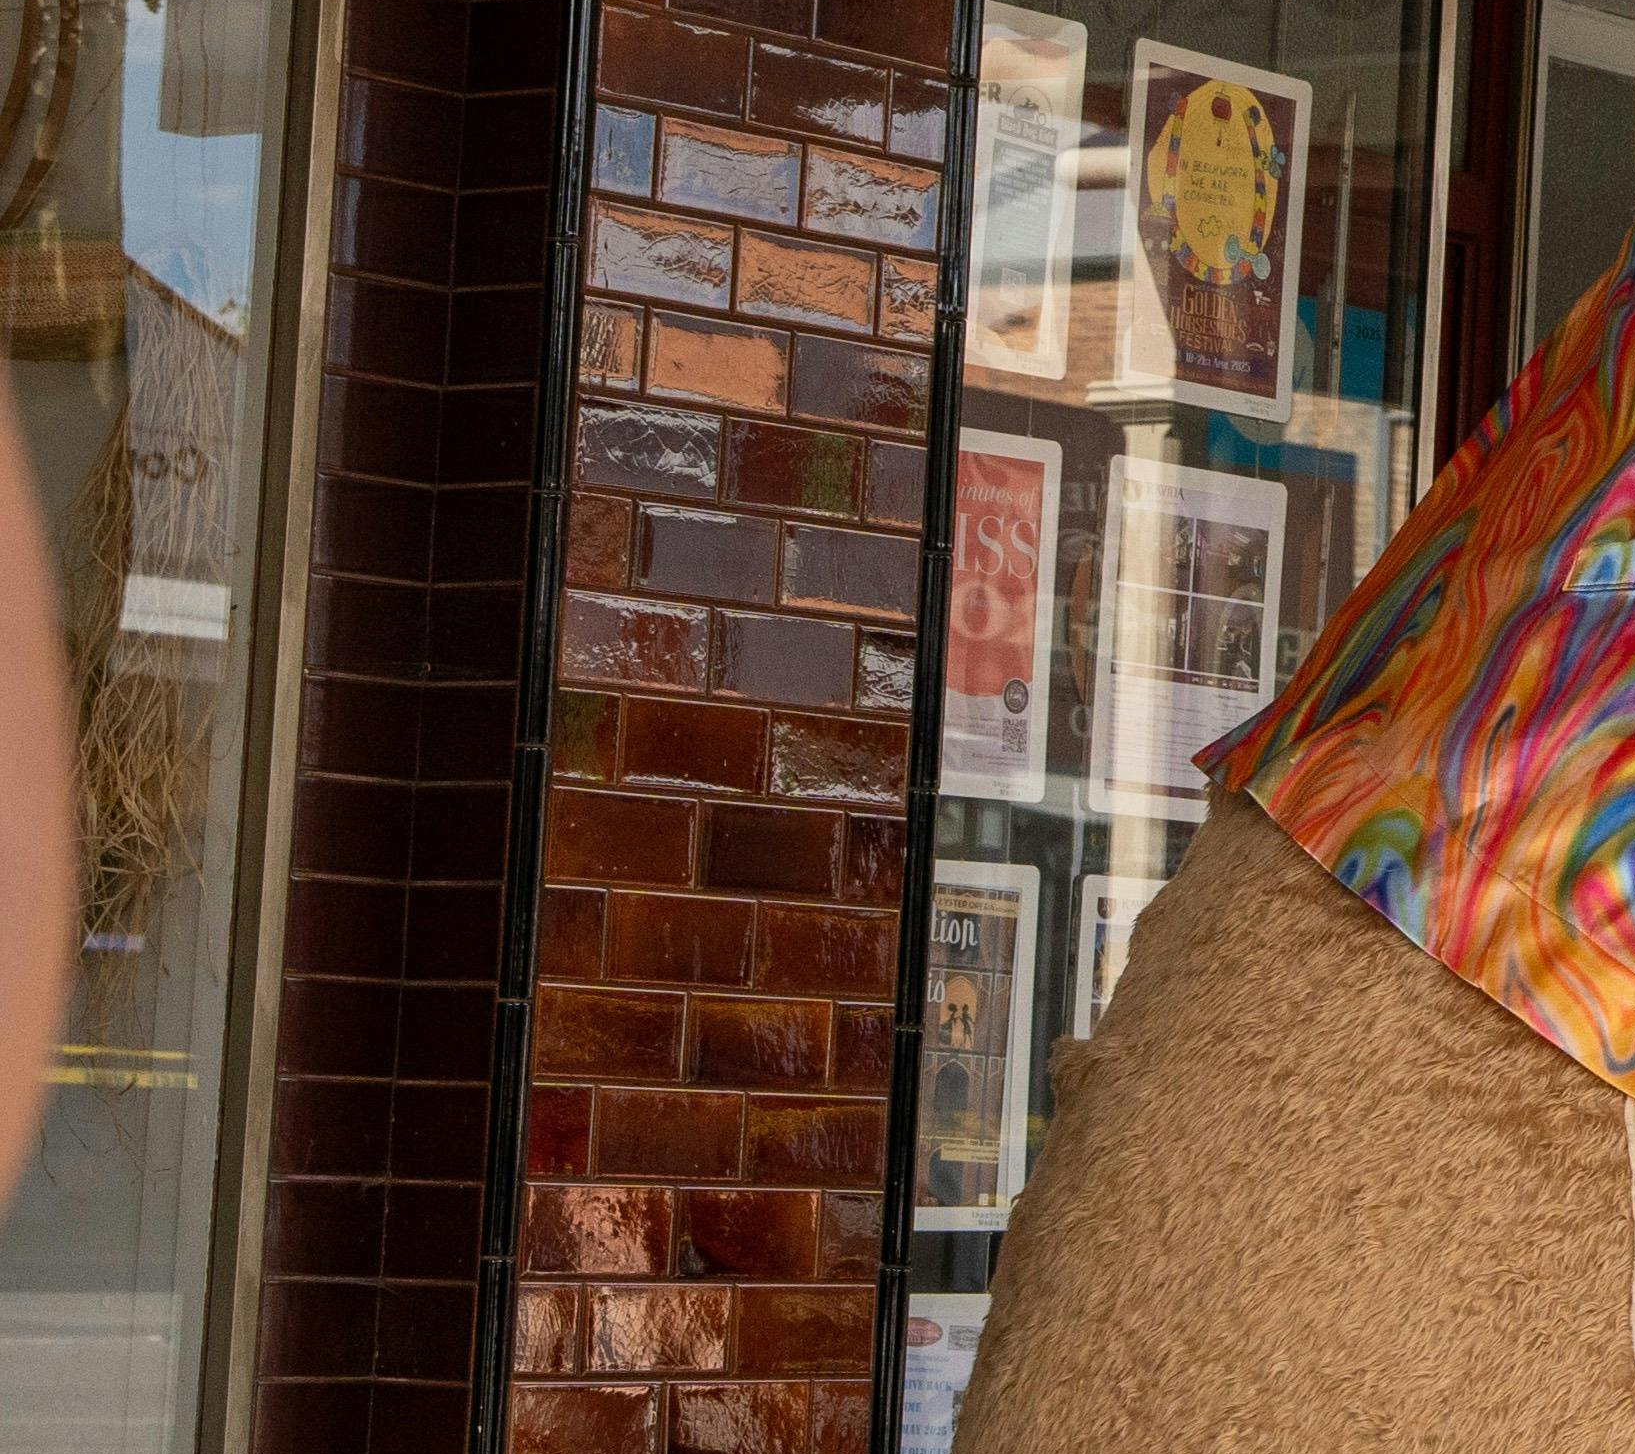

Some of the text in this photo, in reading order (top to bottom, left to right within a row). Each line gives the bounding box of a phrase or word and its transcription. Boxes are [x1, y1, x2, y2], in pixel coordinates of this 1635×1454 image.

[1182, 284, 1238, 324] GOLDEN
[1178, 330, 1233, 355] FESTIVAL
[958, 484, 1015, 504] inutes
[952, 510, 1038, 580] ISS
